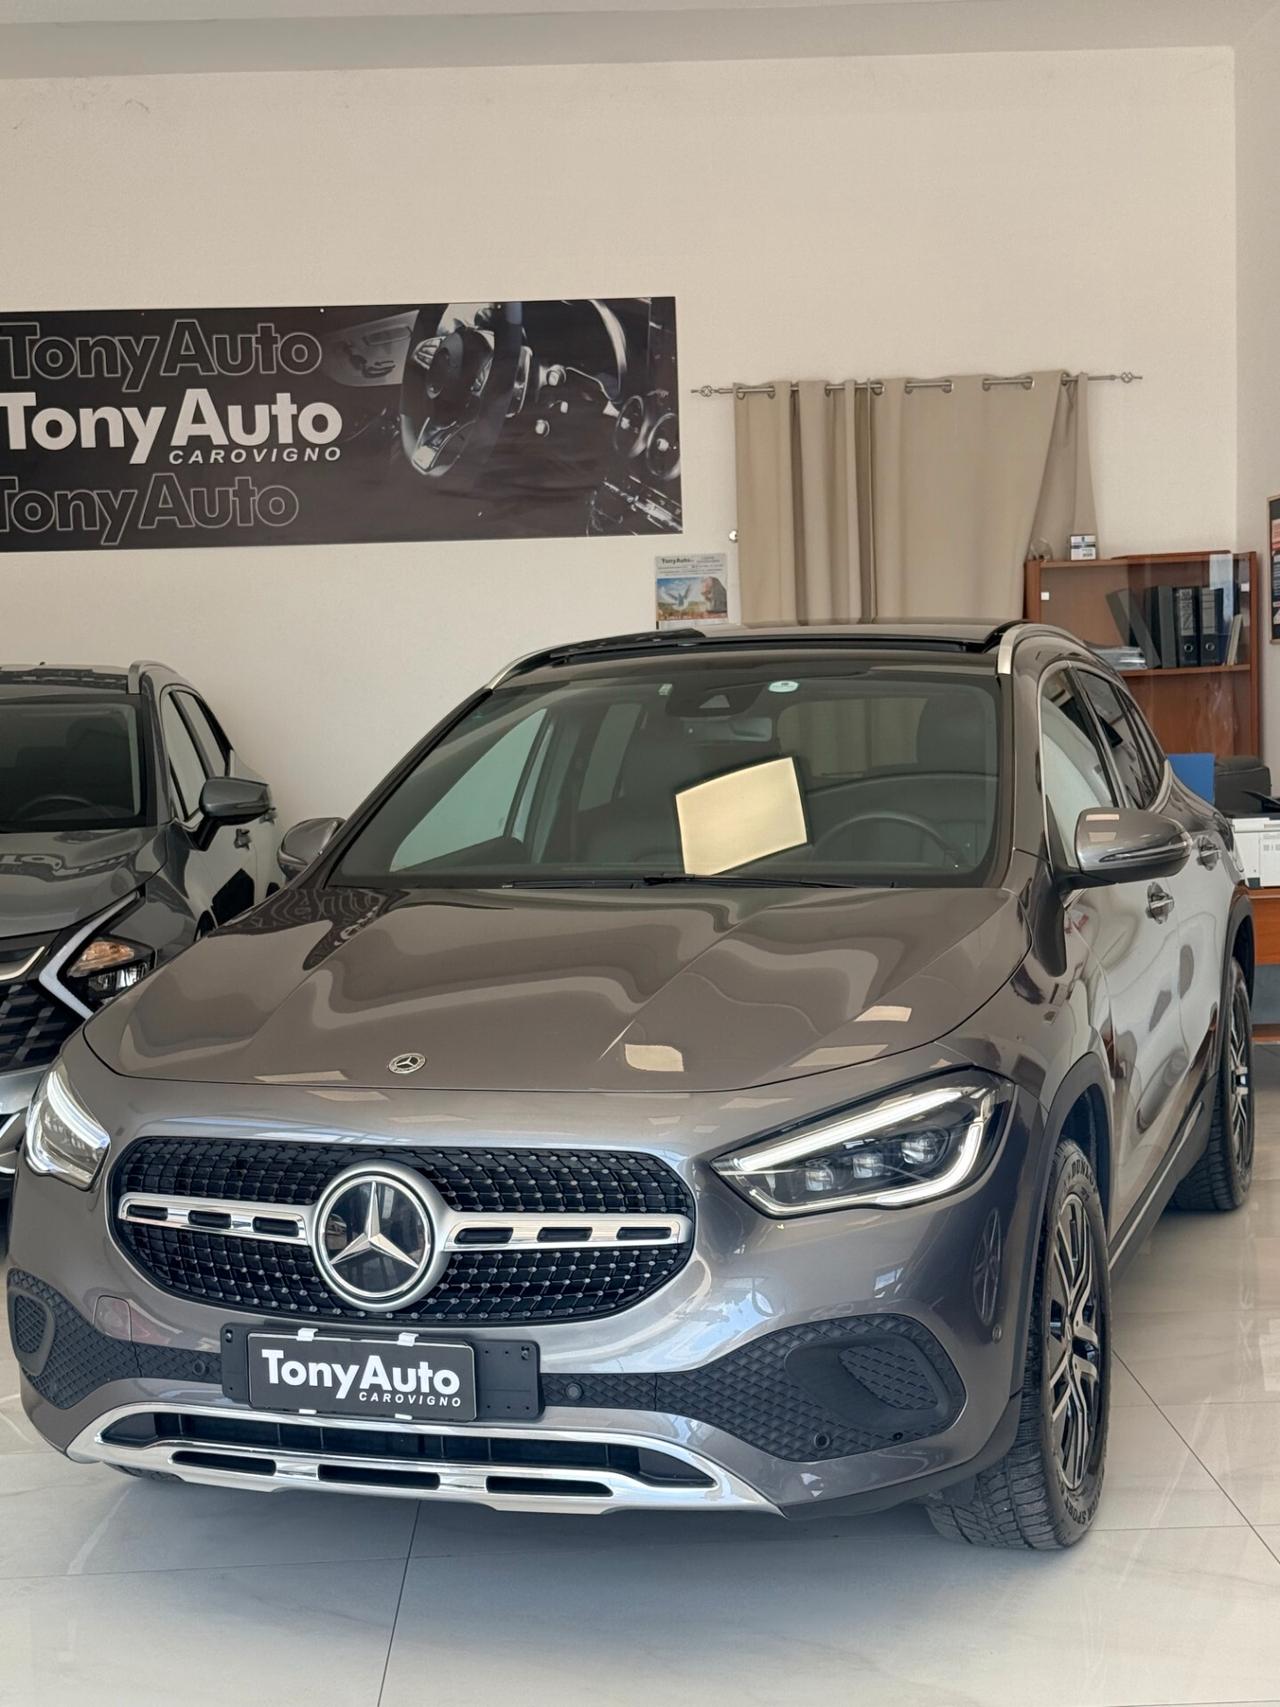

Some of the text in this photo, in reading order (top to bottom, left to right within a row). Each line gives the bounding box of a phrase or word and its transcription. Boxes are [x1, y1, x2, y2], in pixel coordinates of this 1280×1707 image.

[0, 318, 323, 392] TonyAuto
[0, 388, 343, 464] TonyAuto
[168, 446, 342, 465] CAROVIGNO
[261, 1349, 461, 1399] TonyAuto
[359, 1391, 461, 1408] CAROVIGNO
